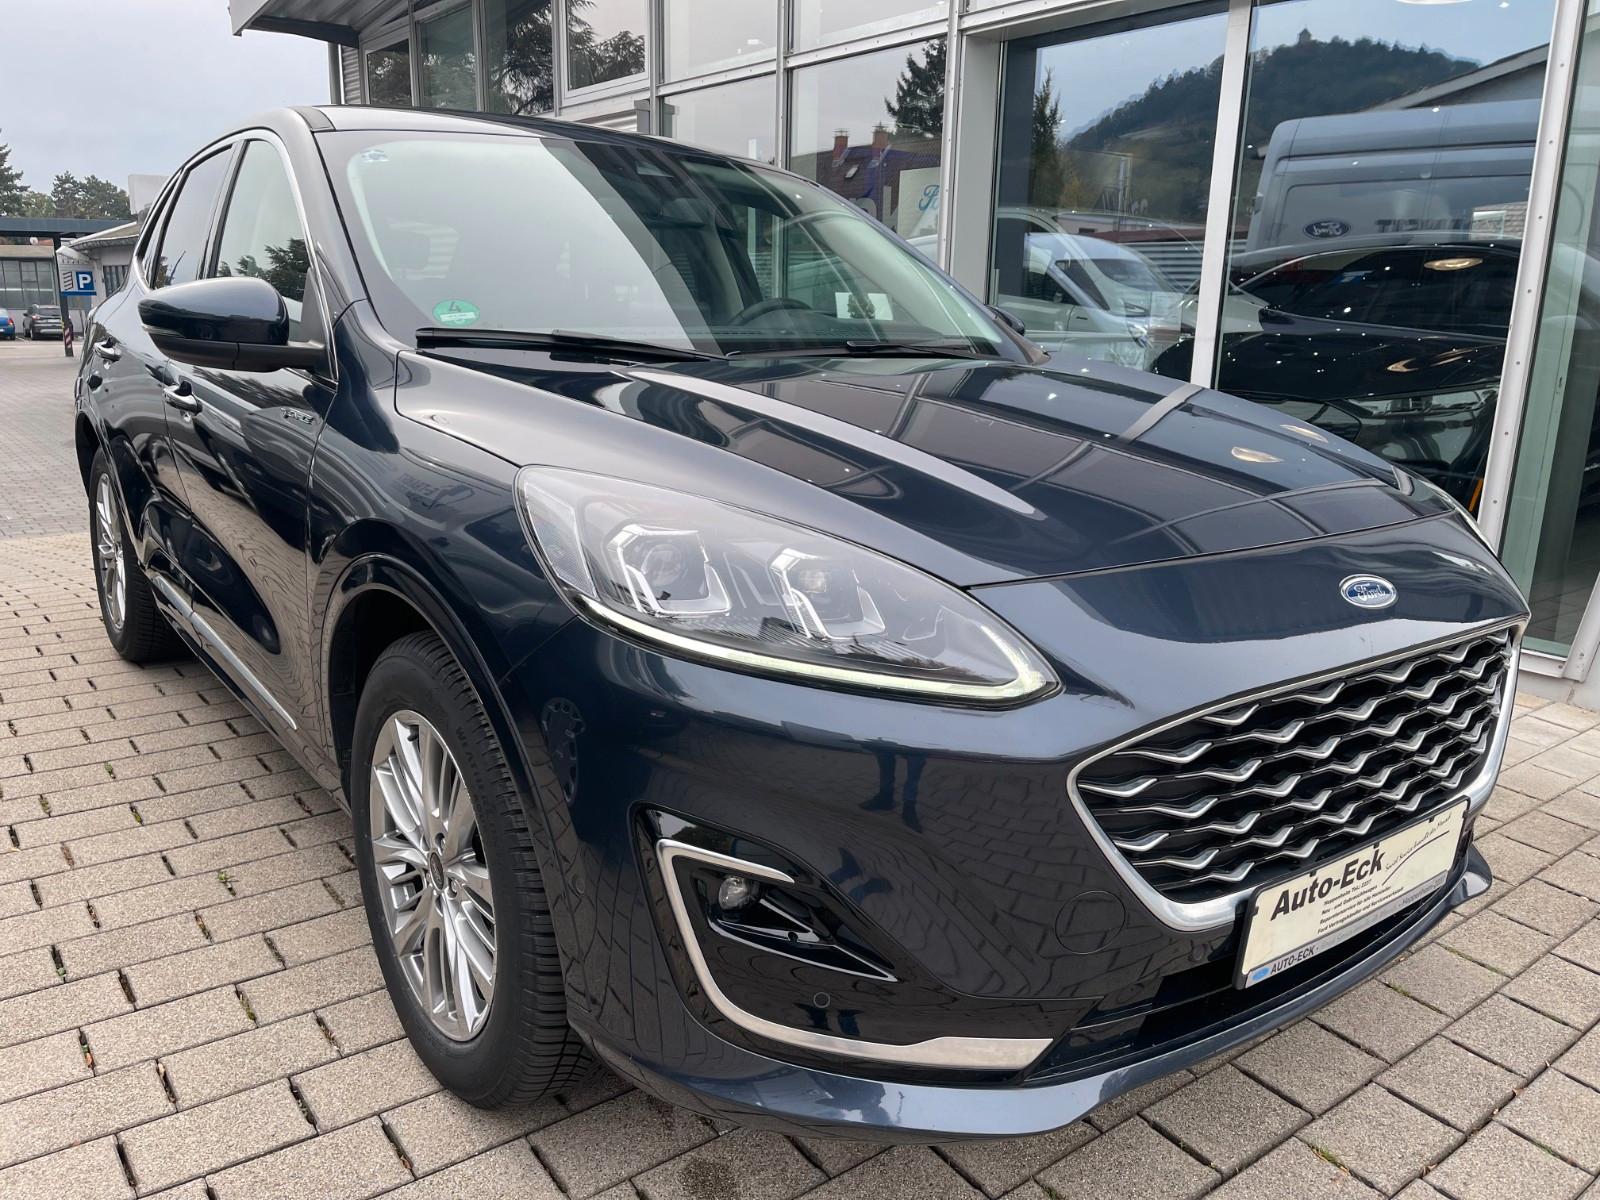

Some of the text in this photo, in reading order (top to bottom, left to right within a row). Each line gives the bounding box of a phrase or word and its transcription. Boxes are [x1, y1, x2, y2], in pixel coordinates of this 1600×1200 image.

[78, 273, 92, 289] P
[1353, 582, 1386, 602] Ford
[1270, 848, 1386, 921] Auto-Eck
[1270, 945, 1315, 975] AUTO-ECK
